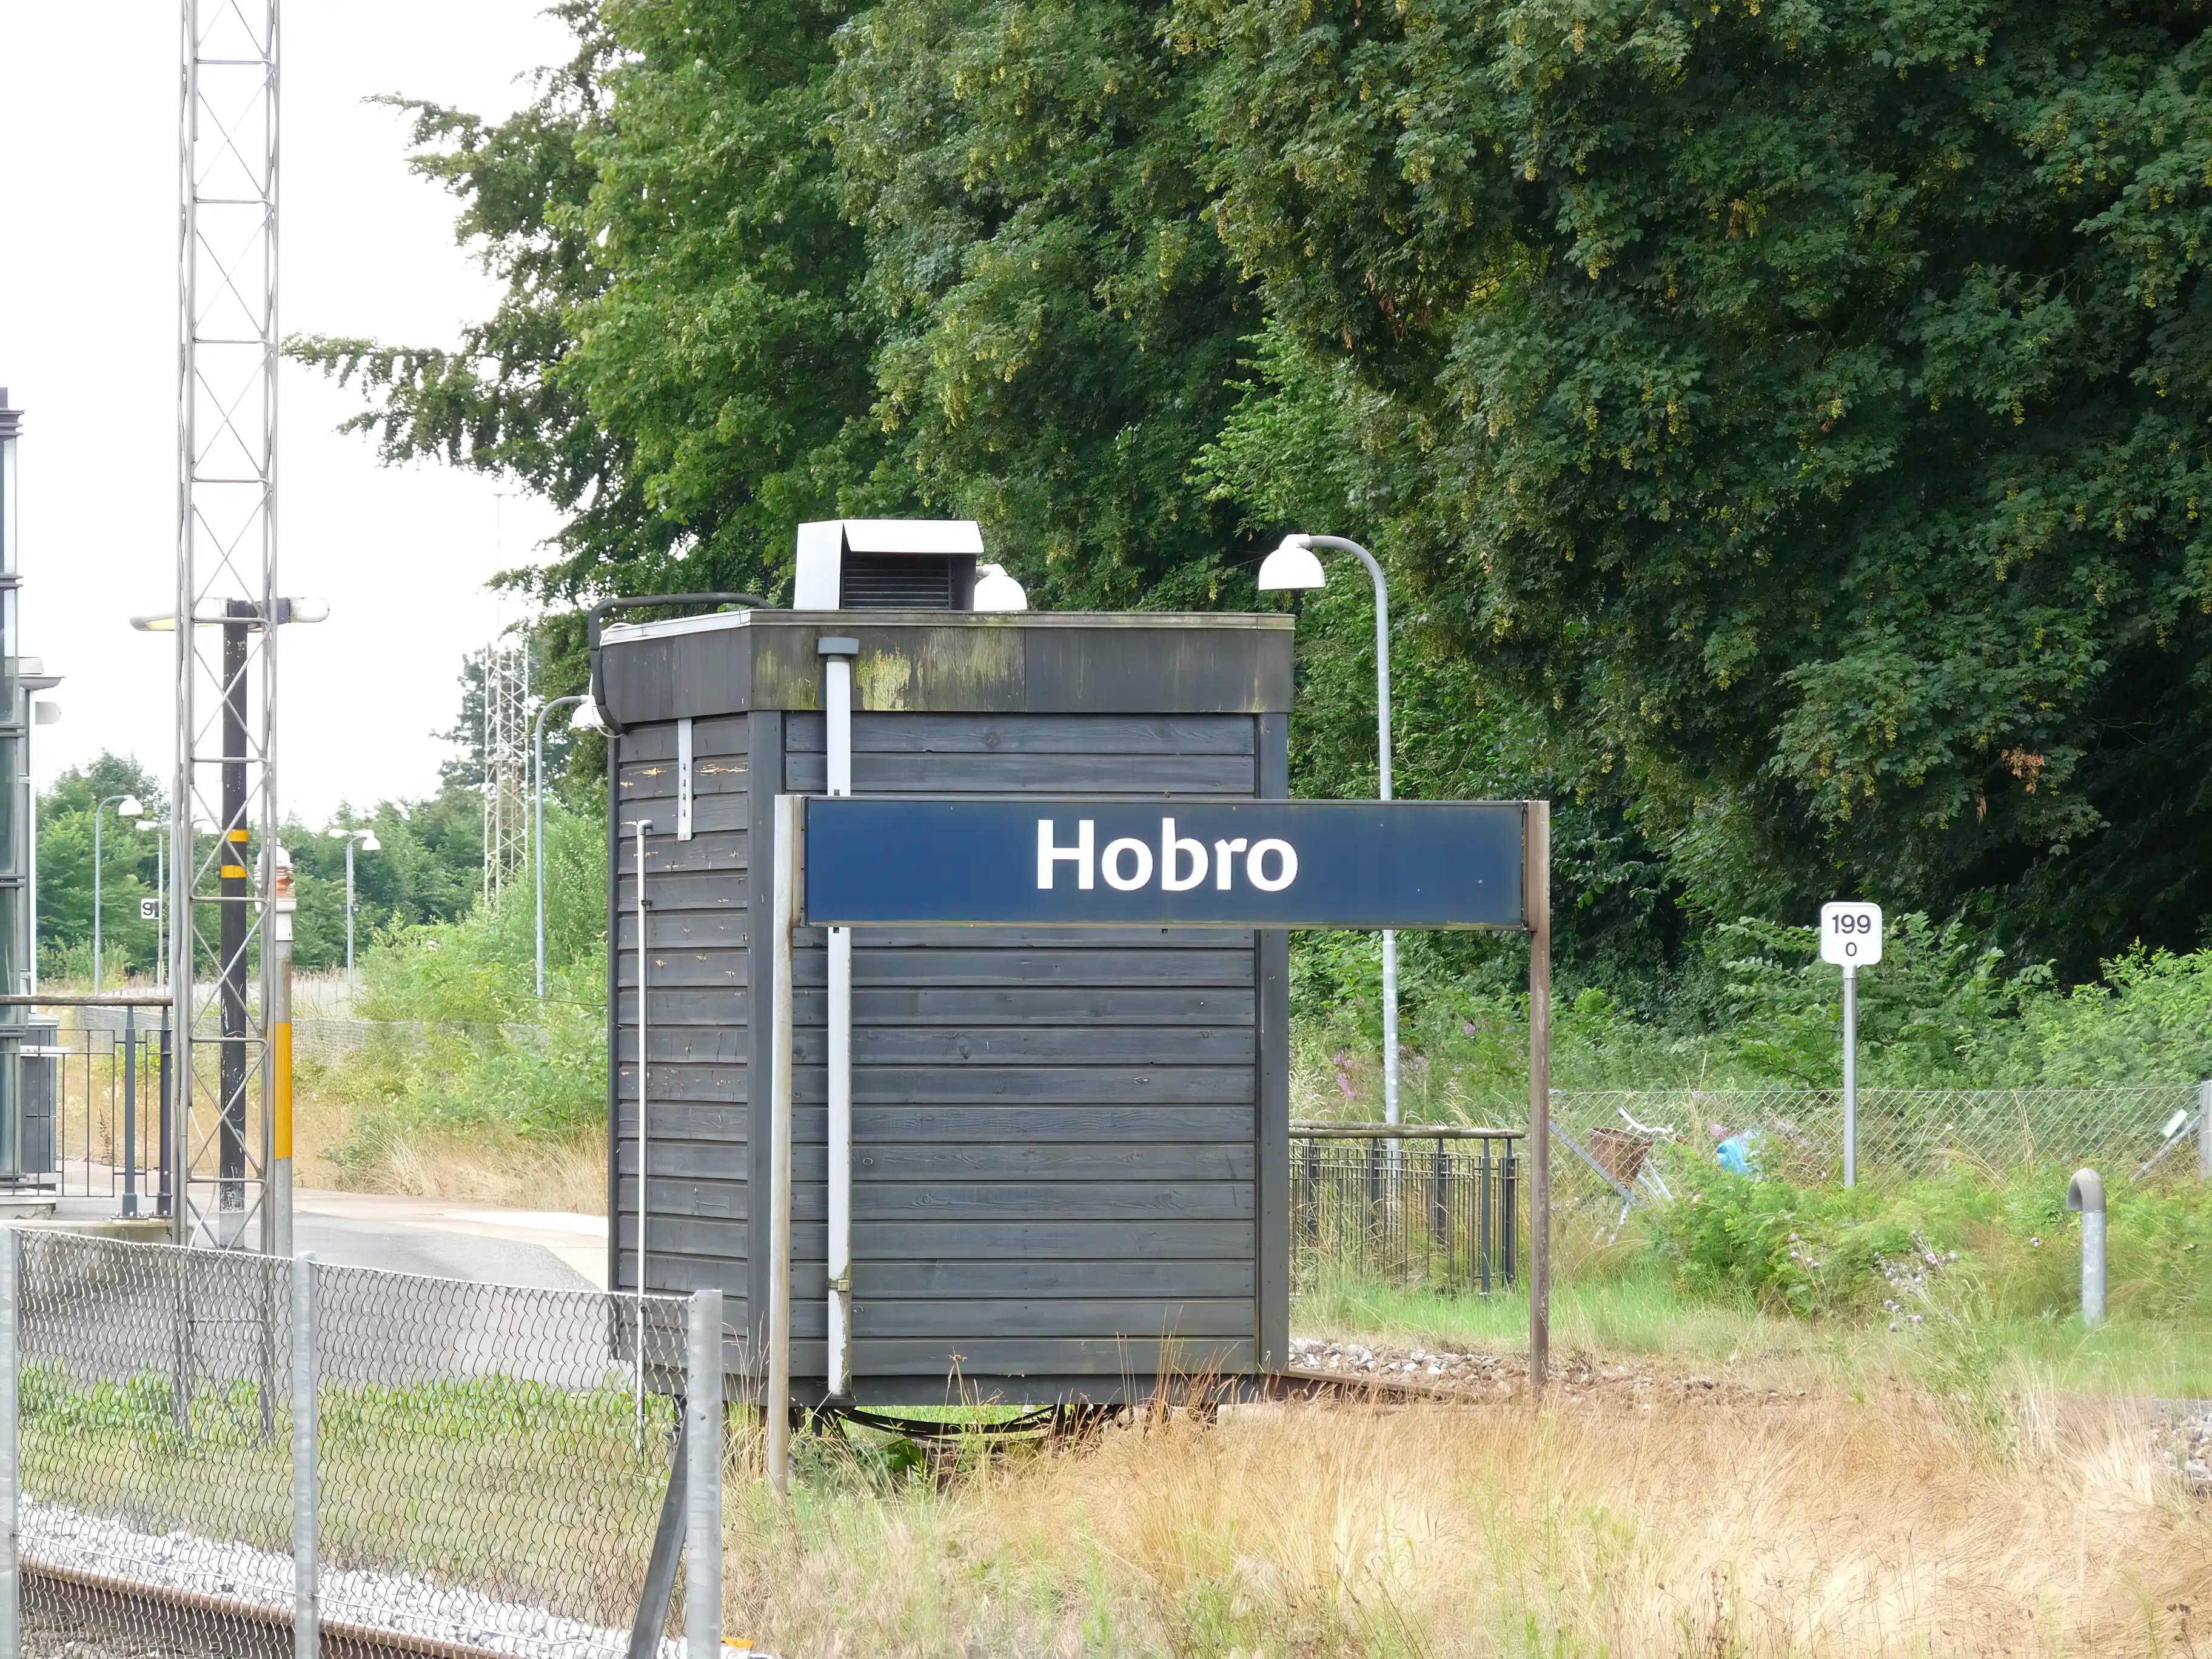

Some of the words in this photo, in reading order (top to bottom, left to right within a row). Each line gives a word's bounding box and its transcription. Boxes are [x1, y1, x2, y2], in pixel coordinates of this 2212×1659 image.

[1037, 817, 1298, 891] Hobro
[1832, 914, 1871, 934] 199
[1845, 942, 1857, 957] 0
